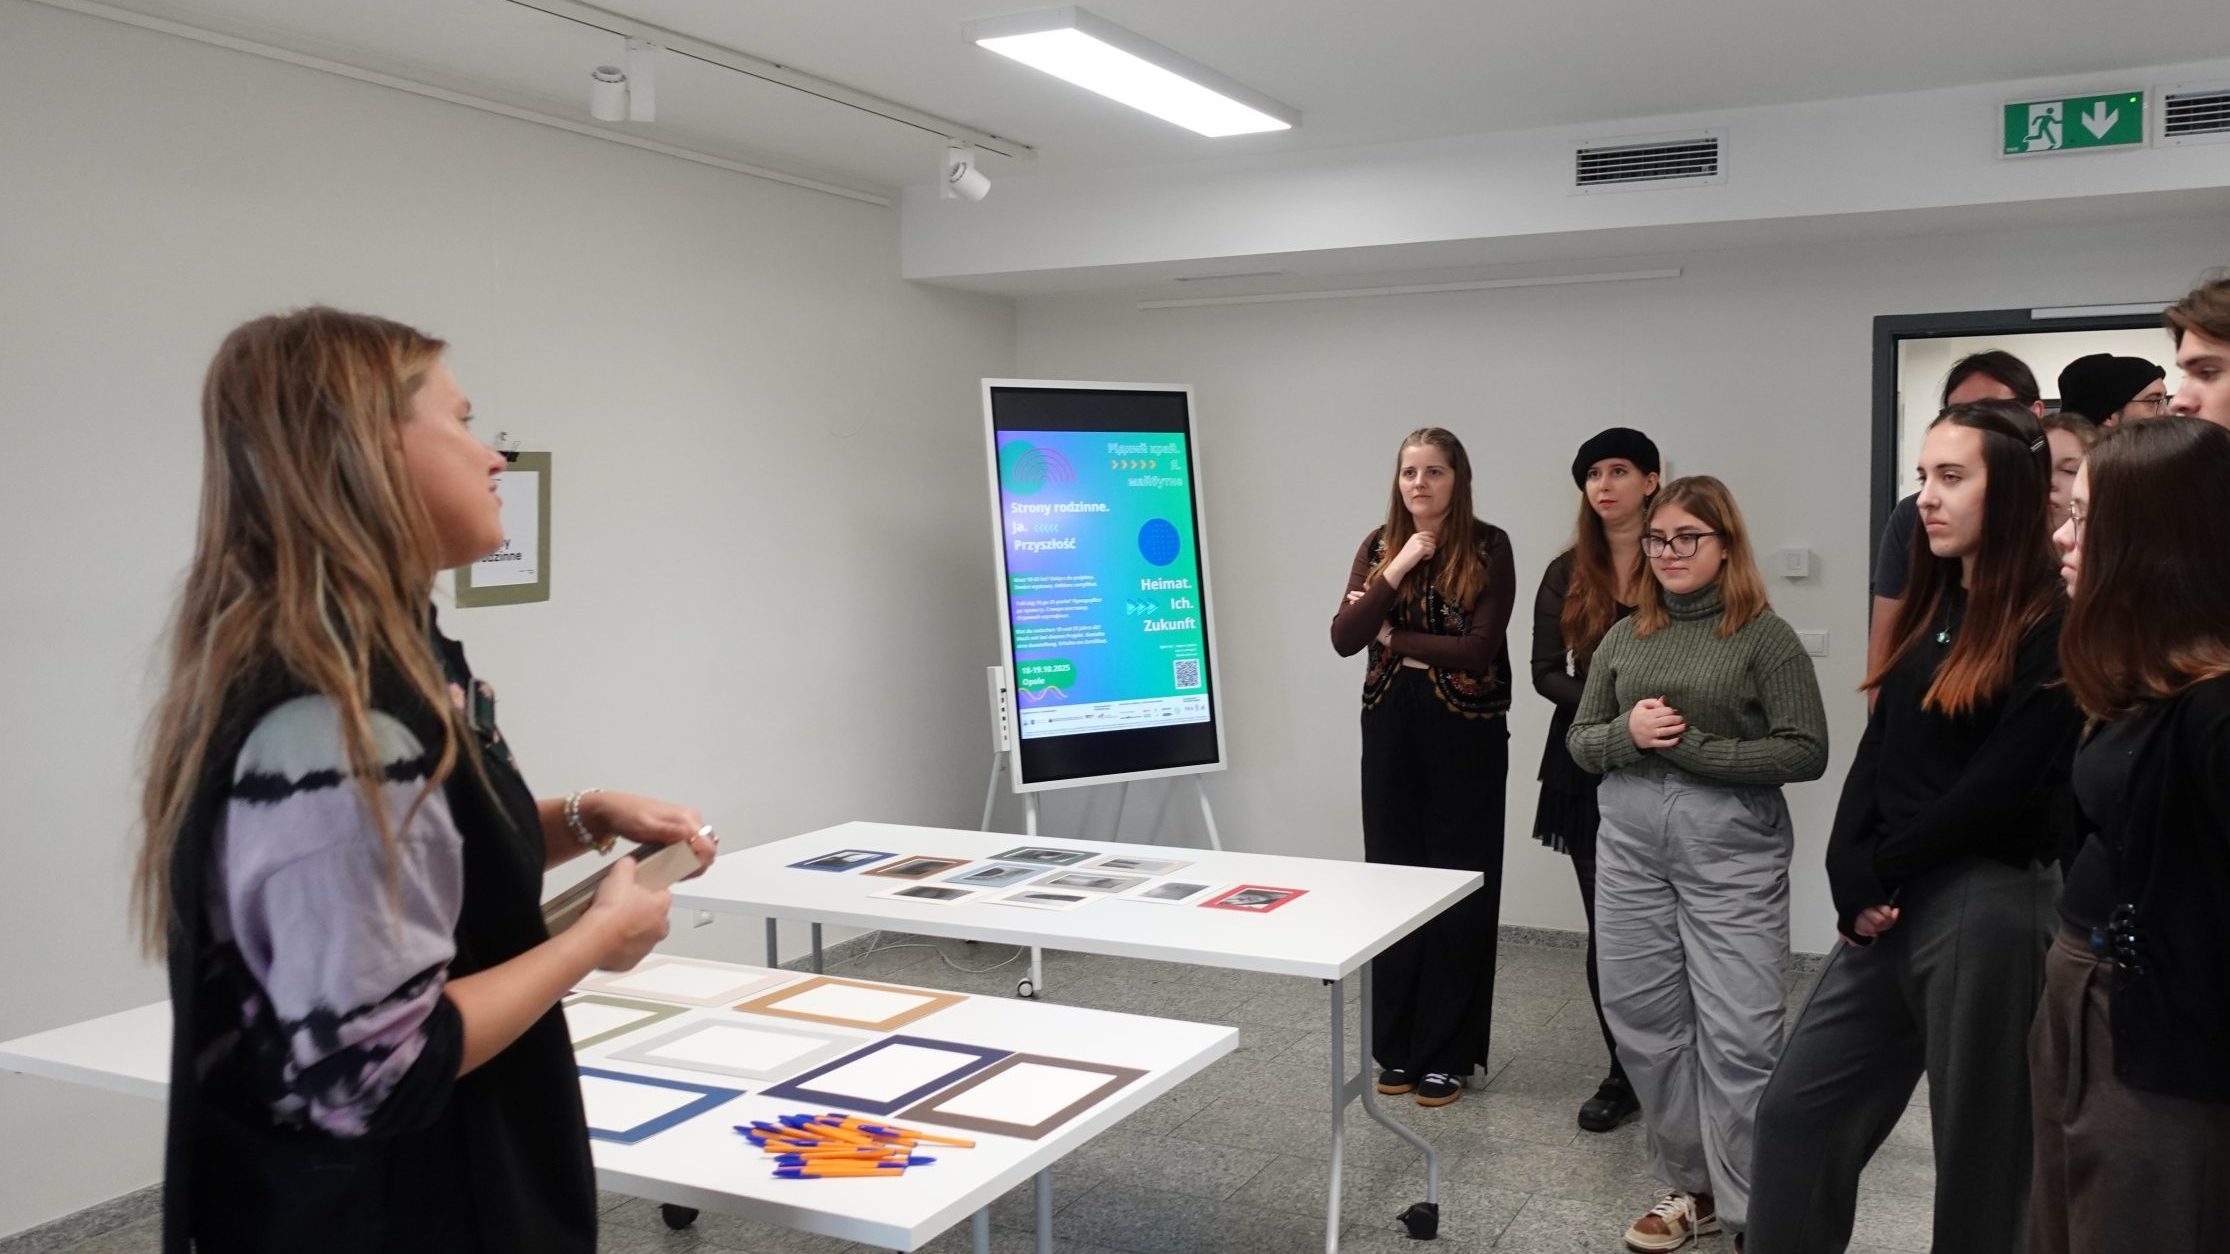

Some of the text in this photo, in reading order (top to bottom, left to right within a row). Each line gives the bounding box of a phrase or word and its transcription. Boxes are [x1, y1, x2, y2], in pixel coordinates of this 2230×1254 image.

[1010, 501, 1110, 516] Strony rodzinne.
[1014, 537, 1077, 553] Przyszłość
[1140, 577, 1192, 591] Heimat.
[1170, 597, 1195, 610] Ich.
[1143, 617, 1197, 632] Zukunft
[1022, 677, 1045, 687] Opole
